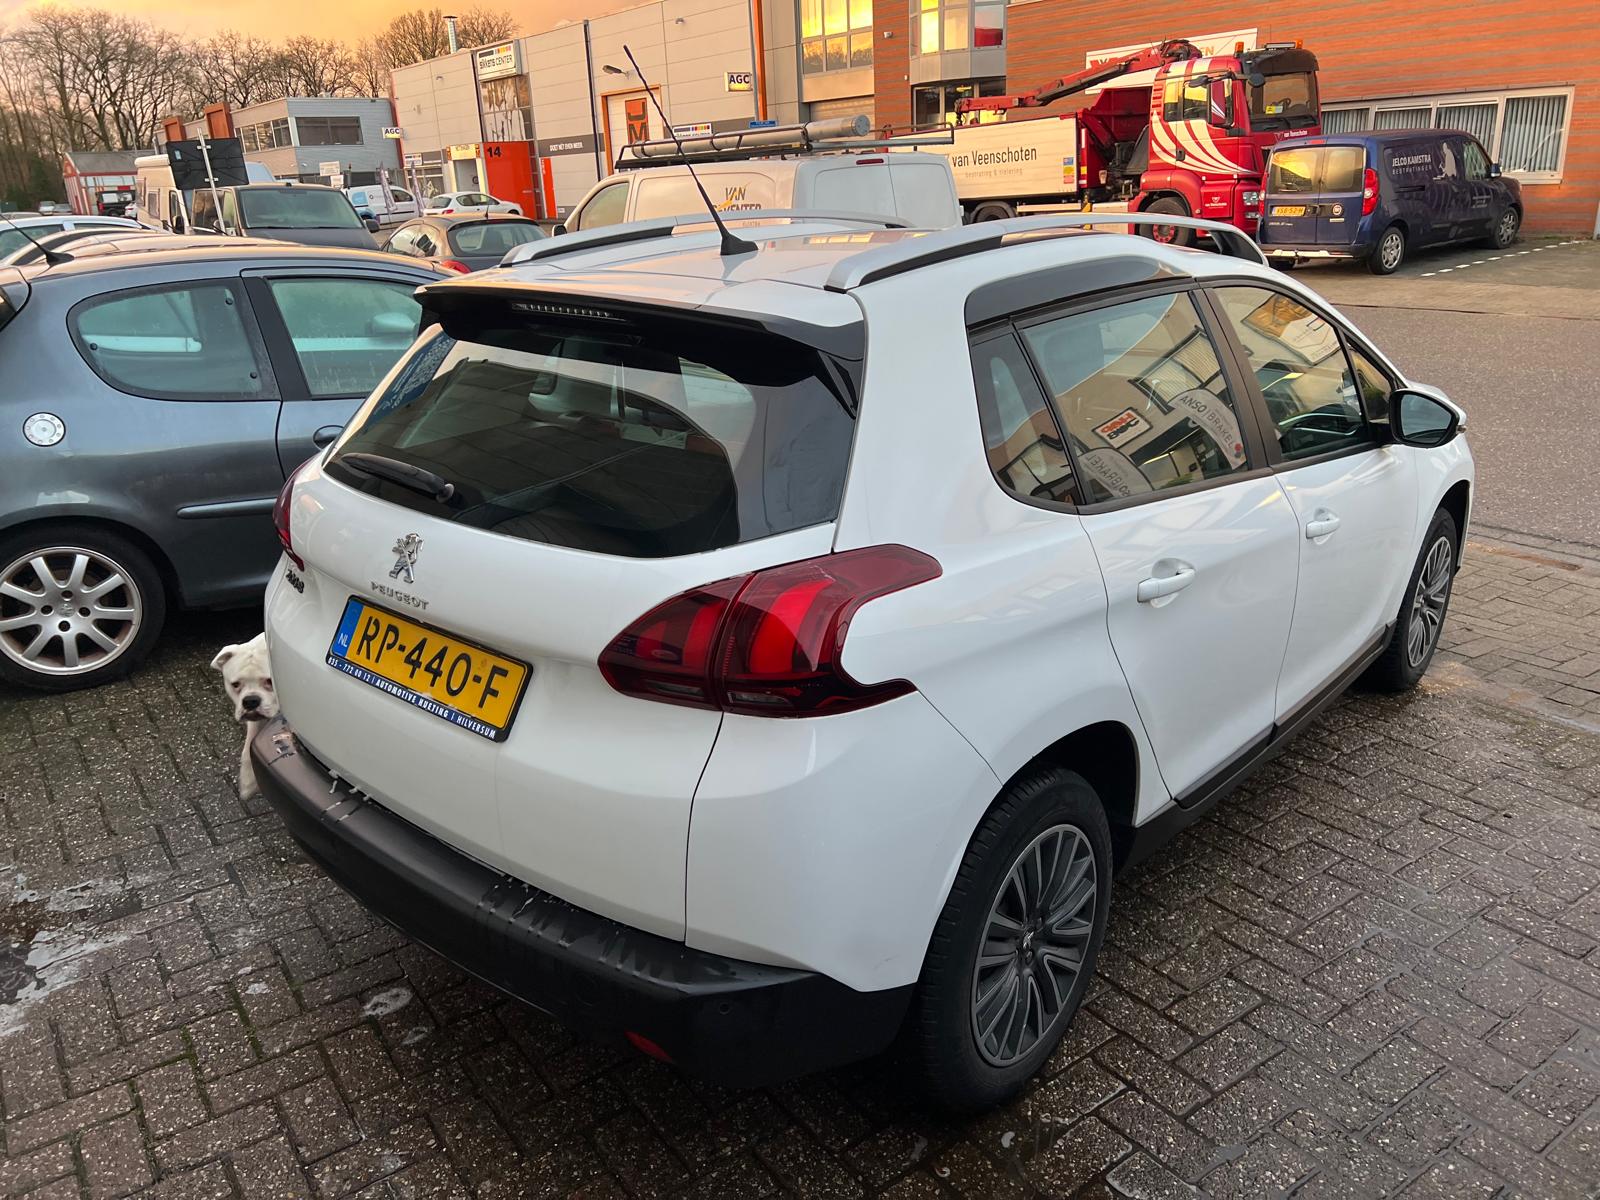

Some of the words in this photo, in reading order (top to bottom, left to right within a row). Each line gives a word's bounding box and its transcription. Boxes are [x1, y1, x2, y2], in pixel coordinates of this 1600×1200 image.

[729, 74, 750, 84] AGC
[487, 146, 501, 158] 14
[952, 155, 969, 168] van
[972, 146, 1037, 166] Veenschoten
[725, 186, 746, 201] VAN
[370, 581, 430, 610] PEUGEOT
[337, 632, 349, 649] NL
[355, 614, 510, 709] RP-440-F
[342, 663, 354, 674] 772
[363, 673, 371, 682] 12
[375, 679, 417, 704] AUTOMOTIVE
[418, 698, 449, 718] HUETING
[456, 715, 496, 739] HILVERSUM
